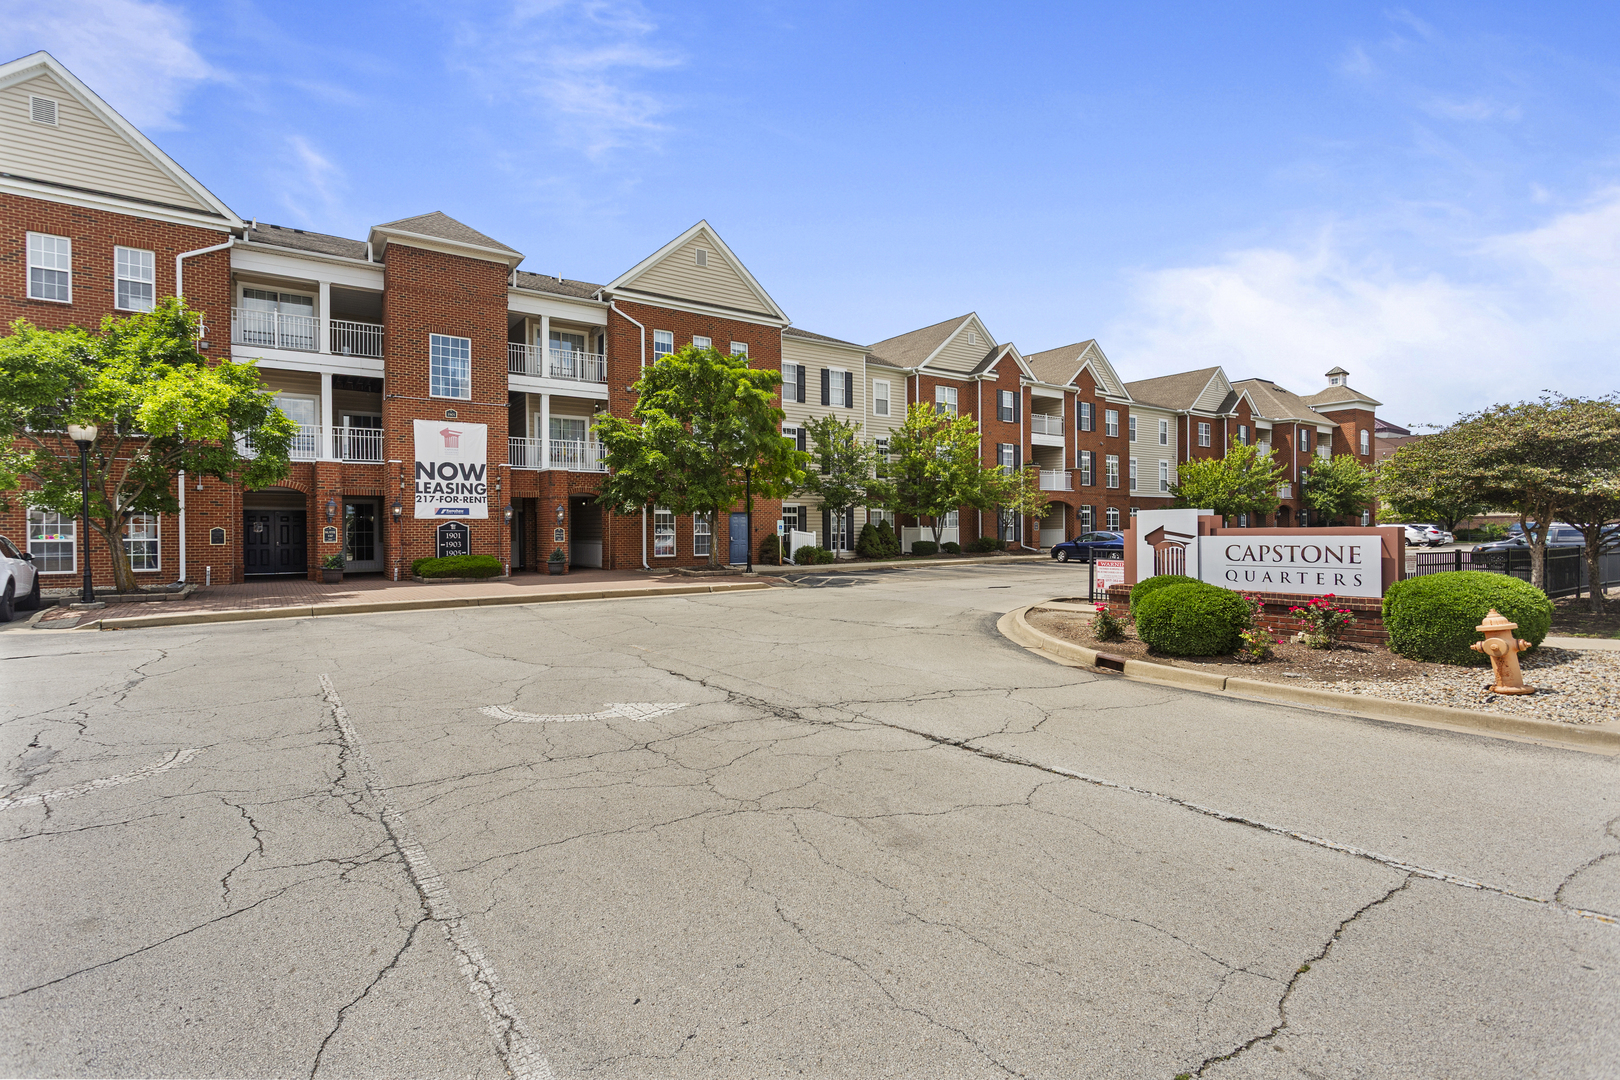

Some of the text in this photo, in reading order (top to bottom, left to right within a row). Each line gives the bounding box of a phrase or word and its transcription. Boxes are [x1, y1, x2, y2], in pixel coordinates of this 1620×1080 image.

[415, 461, 486, 481] NOW
[415, 482, 487, 495] LEASING
[416, 495, 487, 503] 217-FOR-RENT
[1225, 544, 1362, 564] CAPSTONE
[1225, 569, 1362, 587] QUARTERS
